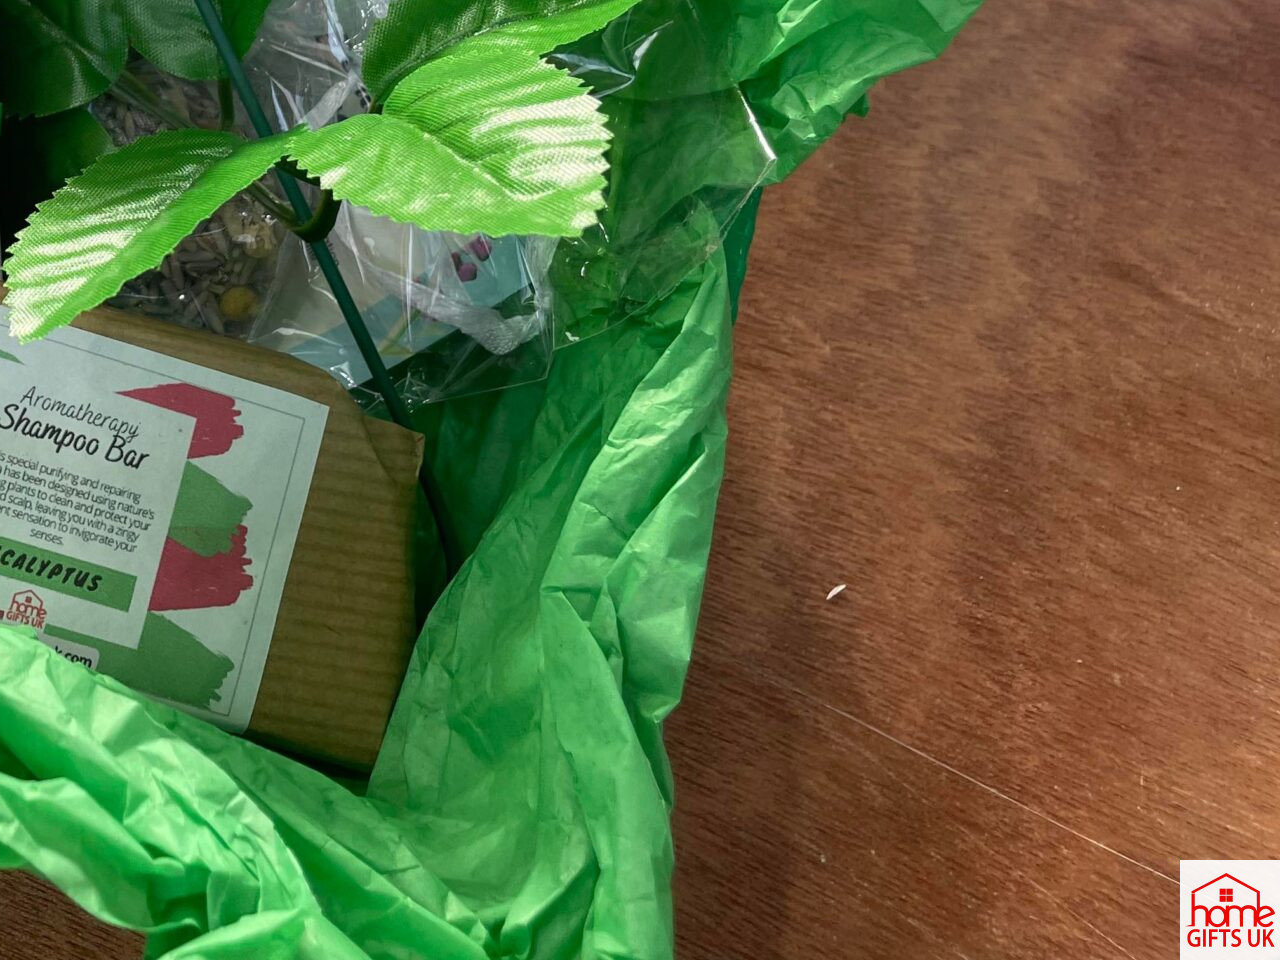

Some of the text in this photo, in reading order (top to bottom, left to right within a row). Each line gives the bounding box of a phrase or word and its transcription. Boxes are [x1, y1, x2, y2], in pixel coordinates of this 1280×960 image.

[20, 386, 141, 443] Aromatherapy
[105, 435, 150, 470] Bar
[3, 465, 21, 479] has
[22, 471, 46, 487] been
[47, 480, 91, 500] designed
[91, 494, 117, 511] using
[117, 501, 155, 520] nature's
[7, 454, 40, 471] special
[39, 464, 79, 486] purifying
[80, 477, 100, 489] and
[100, 483, 141, 505] repairing
[6, 481, 36, 498] plants
[37, 489, 48, 501] to
[49, 493, 74, 508] clean
[74, 502, 94, 514] and
[94, 507, 128, 525] protect
[128, 518, 151, 531] your
[35, 501, 67, 522] leaving
[66, 512, 86, 525] you
[86, 518, 107, 531] with
[107, 525, 115, 534] a
[115, 527, 141, 543] zingy
[11, 508, 56, 529] sensation
[58, 522, 68, 533] to
[69, 525, 115, 547] invigorate
[113, 539, 138, 553] your
[6, 611, 43, 629] GIFTS UK
[9, 600, 47, 620] home
